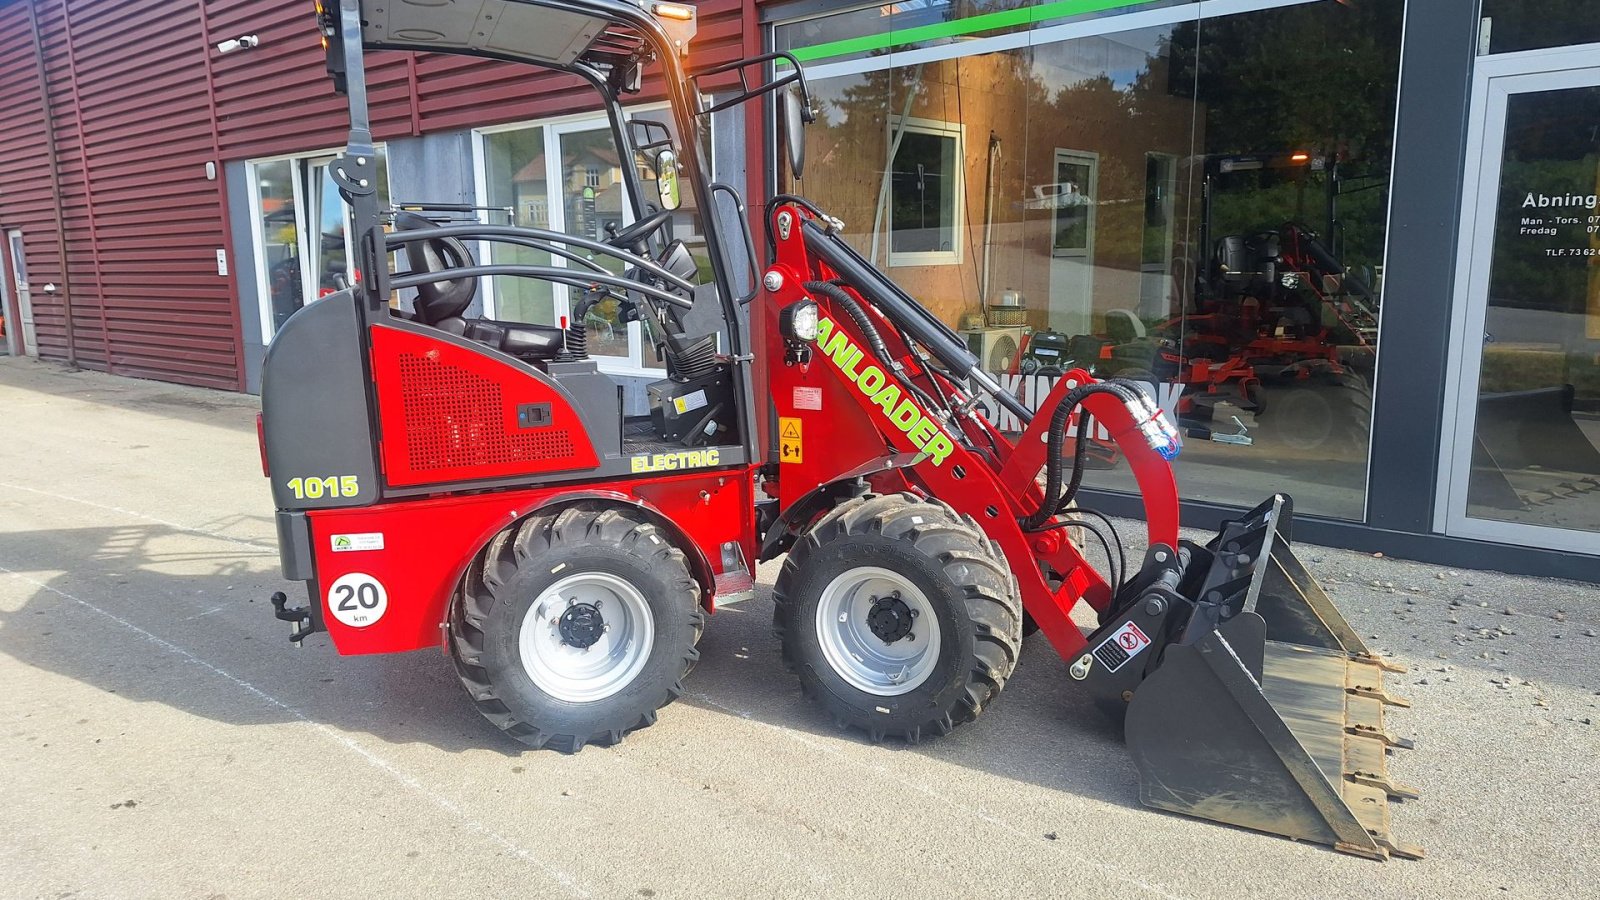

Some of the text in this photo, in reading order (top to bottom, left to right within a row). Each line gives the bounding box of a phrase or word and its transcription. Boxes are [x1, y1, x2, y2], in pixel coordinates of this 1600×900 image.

[1522, 192, 1600, 208] Åbning
[1521, 217, 1543, 225] Man
[1555, 216, 1582, 224] Tors.
[1520, 227, 1557, 236] Fredag
[1583, 248, 1596, 256] 62
[815, 317, 954, 467] ANLOADER
[630, 449, 720, 474] ELECTRIC
[287, 474, 360, 500] 1015
[335, 582, 380, 612] 20
[353, 614, 368, 622] km
